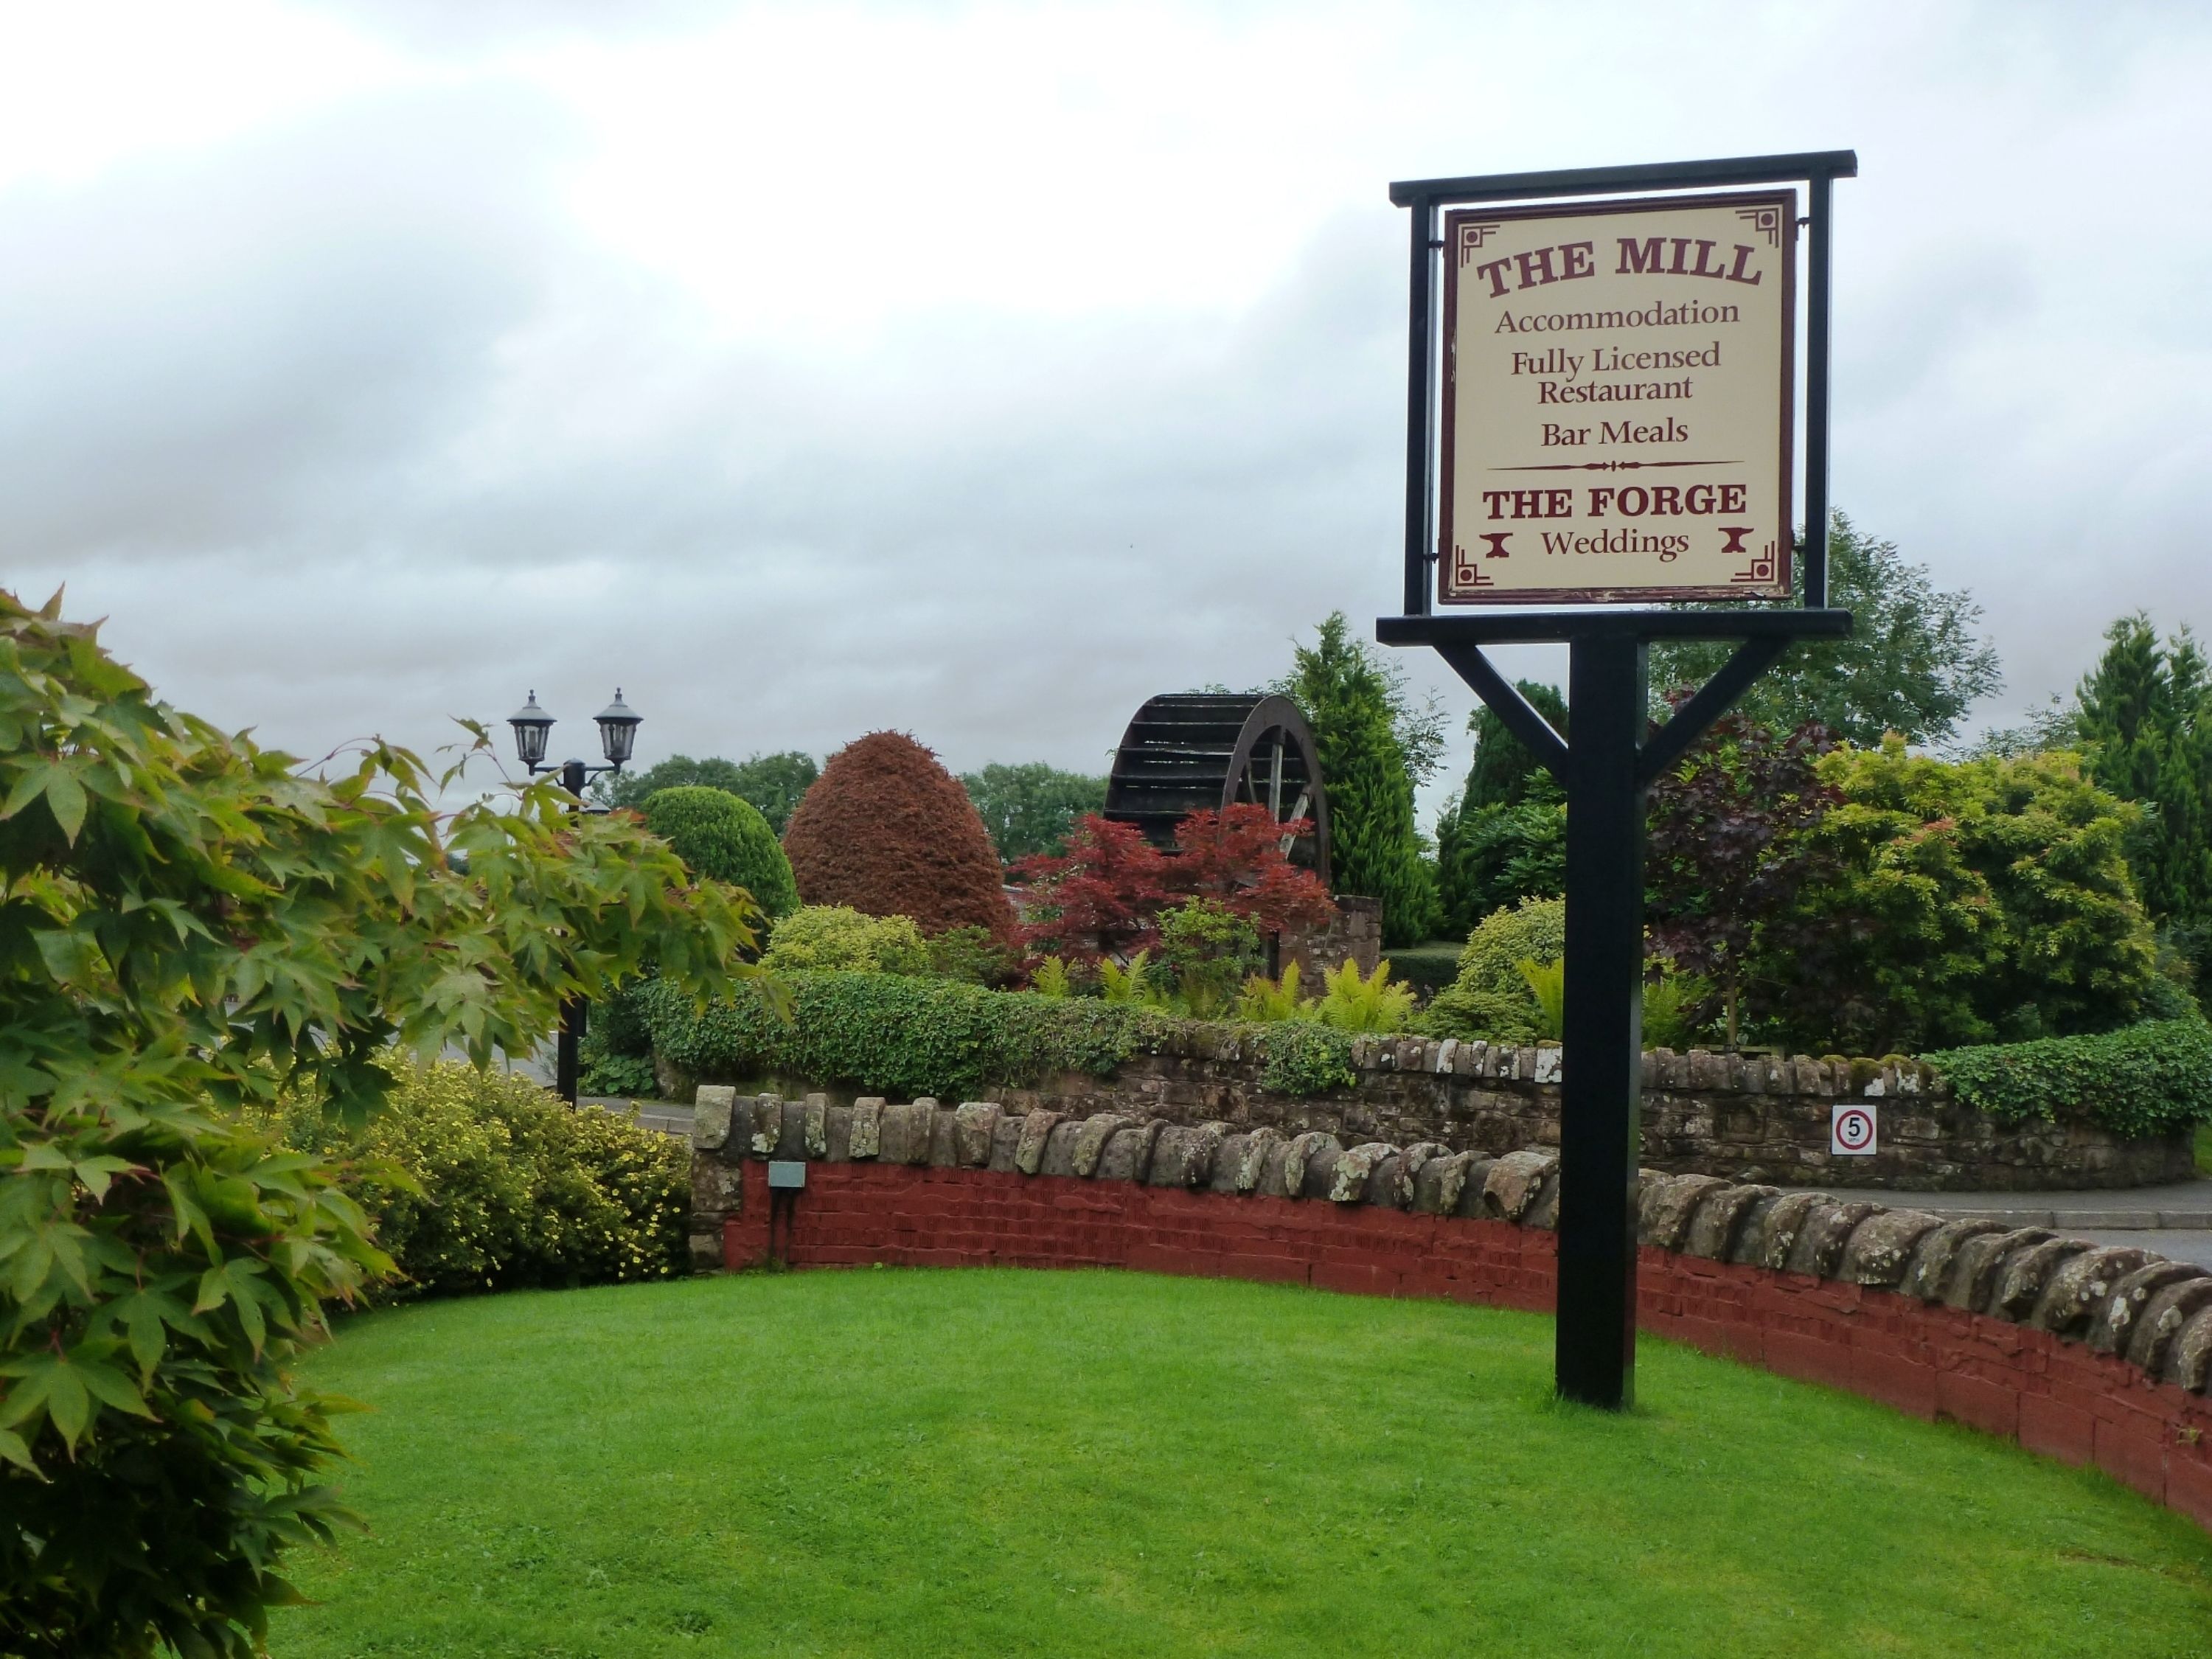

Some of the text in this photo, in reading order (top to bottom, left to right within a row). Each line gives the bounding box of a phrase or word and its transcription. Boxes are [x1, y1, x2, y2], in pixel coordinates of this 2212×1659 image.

[1477, 237, 1763, 299] THE MILL
[1494, 299, 1740, 334] Accommodation
[1510, 341, 1722, 383] Fully Licensed
[1537, 376, 1694, 405] Restaurant
[1540, 417, 1688, 447] Bar Meals
[1482, 484, 1747, 521] THE FORGE
[1541, 527, 1689, 563] Weddings
[1848, 1117, 1860, 1137] 5
